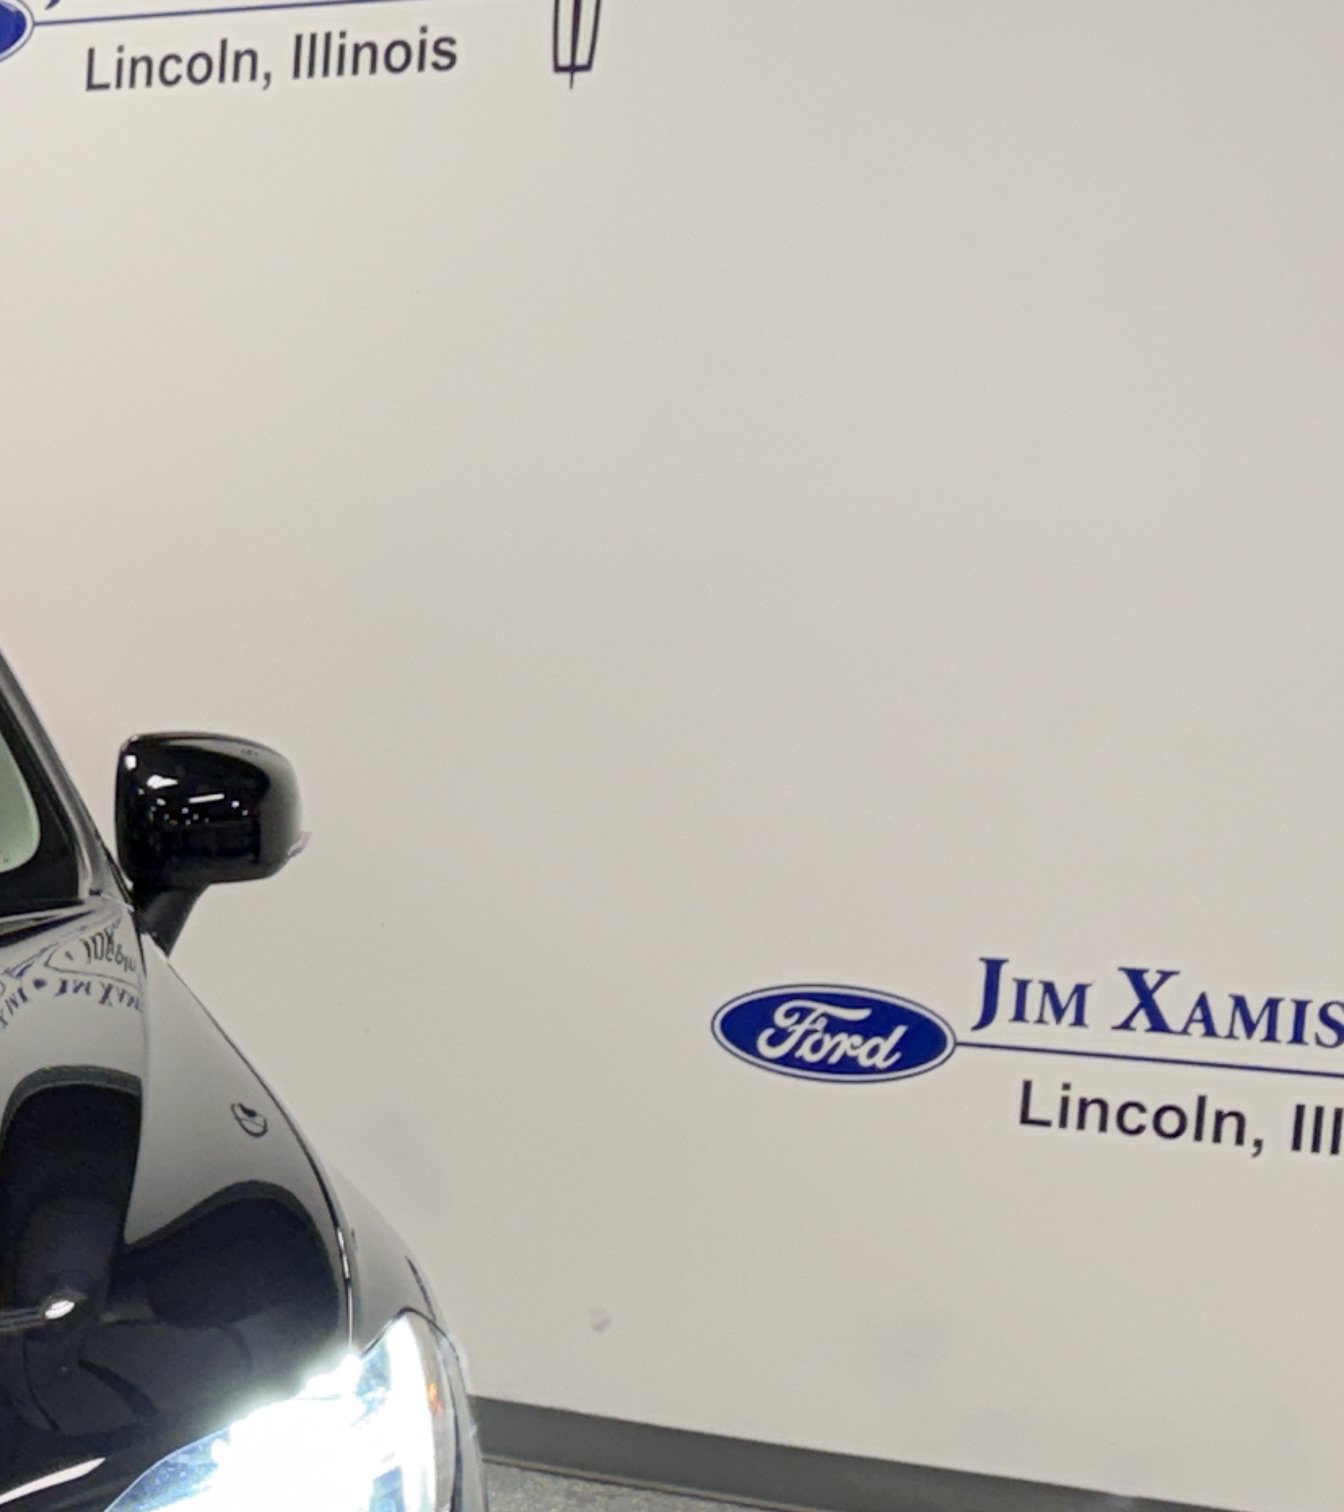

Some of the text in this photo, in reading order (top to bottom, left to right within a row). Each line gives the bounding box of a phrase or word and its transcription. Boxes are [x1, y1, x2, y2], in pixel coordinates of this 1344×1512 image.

[85, 25, 457, 92] Lincoln, Illinois
[755, 999, 908, 1070] Ford
[970, 957, 1344, 1049] JIM XAMIS
[1019, 1079, 1263, 1158] Lincoln,
